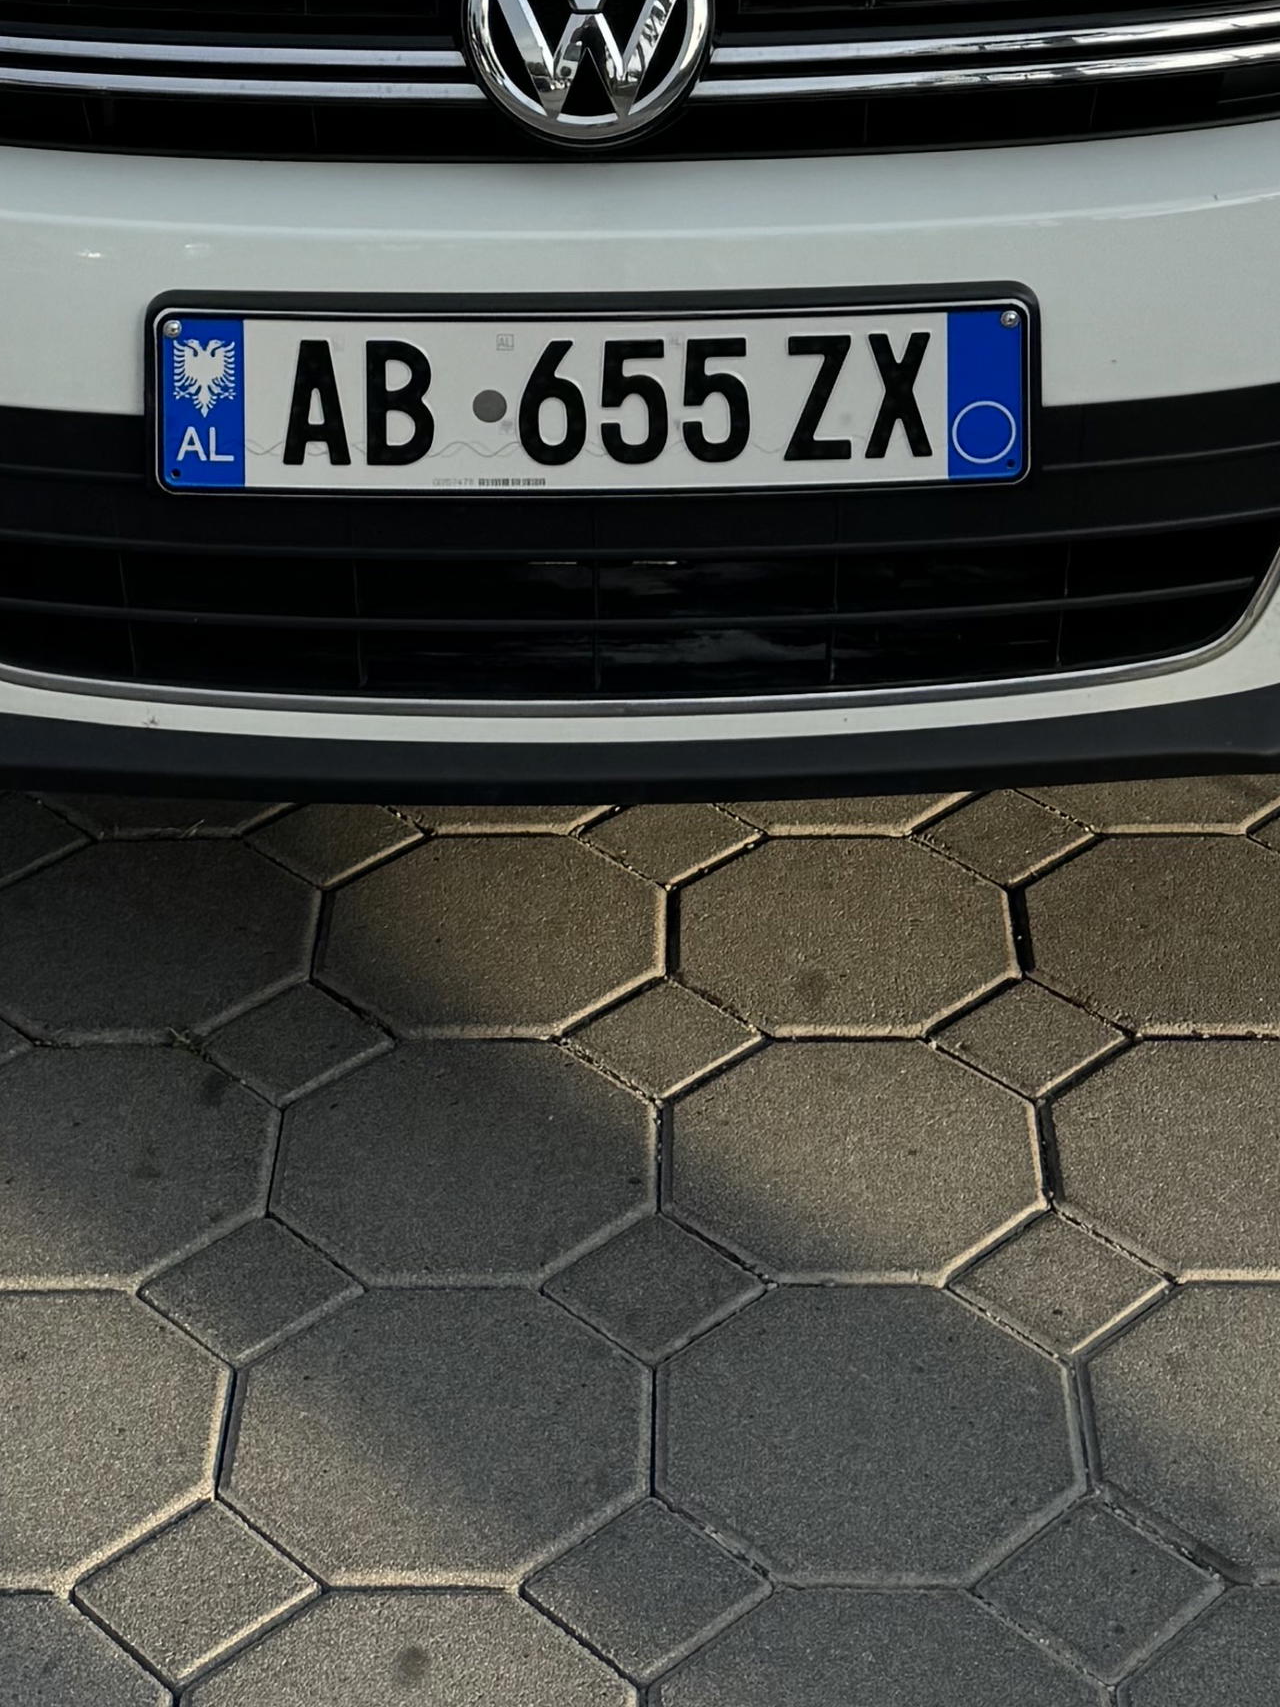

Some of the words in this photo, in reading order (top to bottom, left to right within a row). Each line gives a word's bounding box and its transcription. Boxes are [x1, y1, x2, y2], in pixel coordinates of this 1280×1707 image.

[282, 339, 436, 467] AB
[518, 336, 751, 467] 655
[783, 331, 934, 463] ZX
[176, 425, 235, 462] AL
